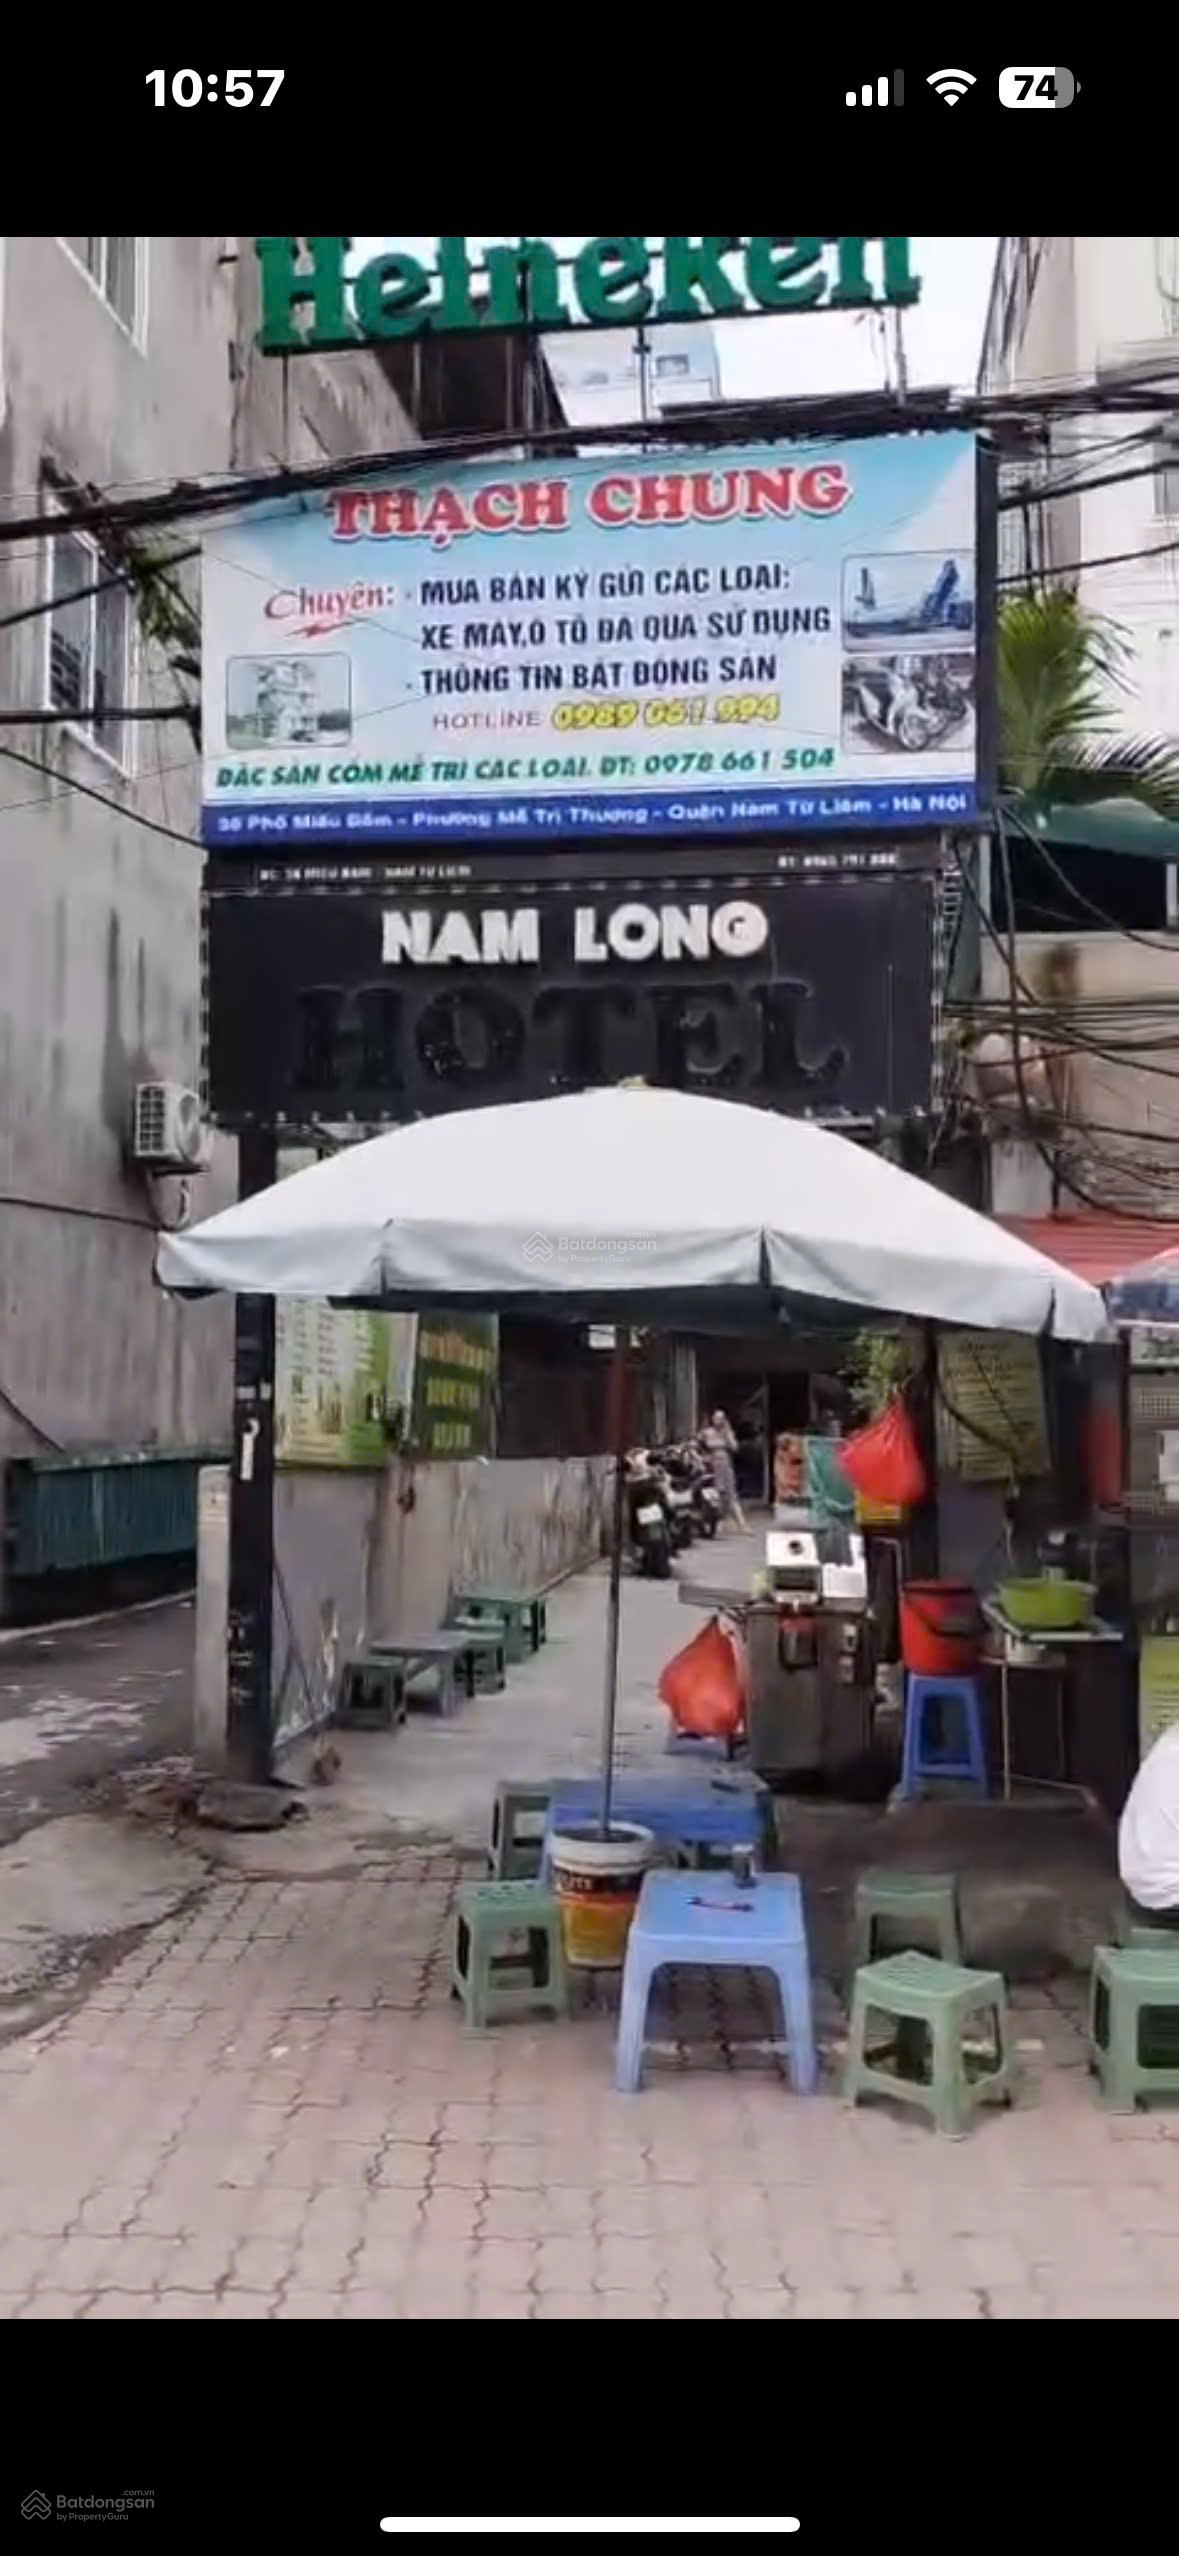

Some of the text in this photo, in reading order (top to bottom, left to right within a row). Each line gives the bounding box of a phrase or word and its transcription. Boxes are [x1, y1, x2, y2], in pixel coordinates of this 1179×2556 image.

[254, 236, 922, 352] Heineken
[328, 463, 850, 548] THẠCH CHUNG
[264, 581, 394, 620] Chuyên:
[420, 578, 480, 606] MUA
[421, 622, 454, 650] XE
[643, 613, 697, 643] QUA
[519, 662, 563, 690] TIN
[433, 709, 540, 730] HOTLINE
[645, 751, 713, 775] 0978
[721, 749, 770, 772] 661
[782, 747, 834, 770] 504
[382, 900, 768, 964] NAM LONG
[293, 978, 850, 1091] HOTEL
